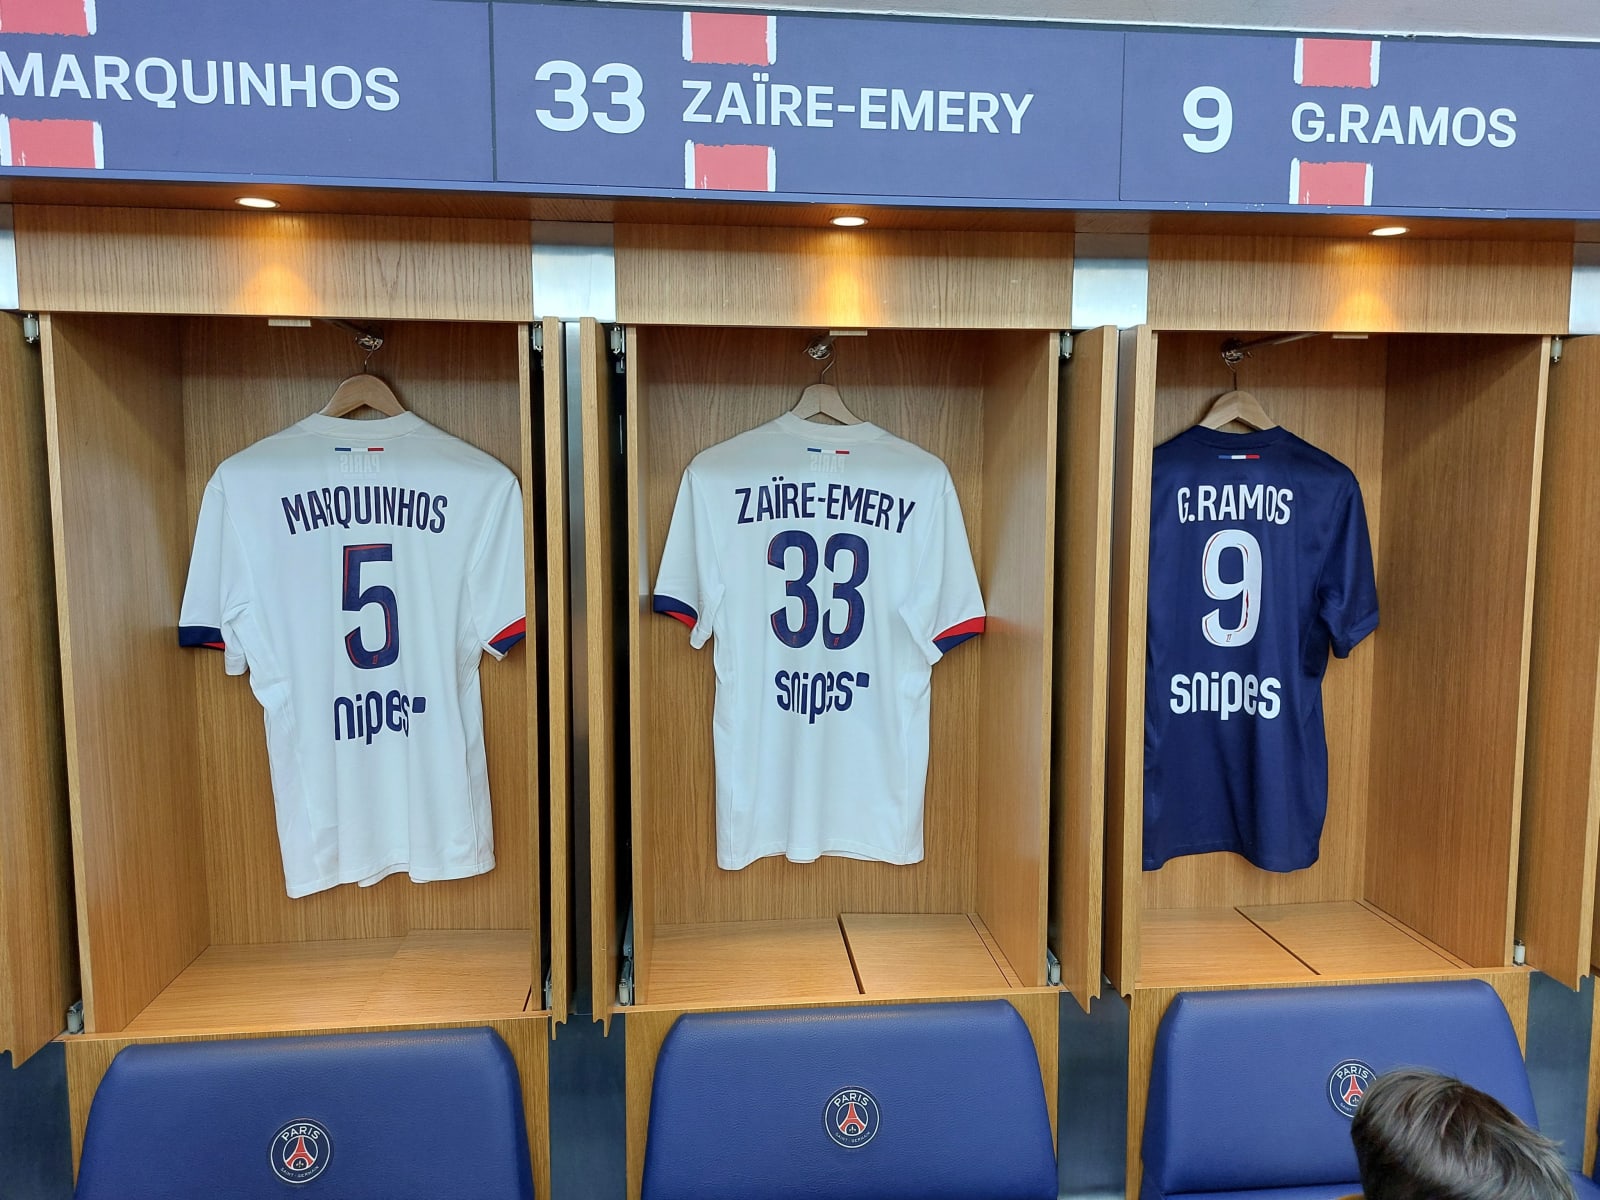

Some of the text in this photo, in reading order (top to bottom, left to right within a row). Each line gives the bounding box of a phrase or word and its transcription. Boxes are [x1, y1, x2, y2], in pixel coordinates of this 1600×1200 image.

[0, 51, 400, 112] MARQUINHOS
[535, 61, 1034, 134] 33 ZAÏRE-EMERY
[1183, 86, 1517, 153] 9 G.RAMOS
[281, 485, 448, 535] MARQUINHOS
[734, 476, 916, 534] ZAÏRE-EMERY
[1177, 484, 1294, 525] G.RAMOS
[342, 543, 400, 670] 5
[767, 530, 870, 650] 33
[1202, 529, 1263, 647] 9
[774, 669, 855, 725] snipes
[1169, 671, 1282, 721] snipes
[833, 1092, 869, 1107] PARIS
[1336, 1066, 1369, 1080] PARIS
[281, 1126, 321, 1141] PARIS
